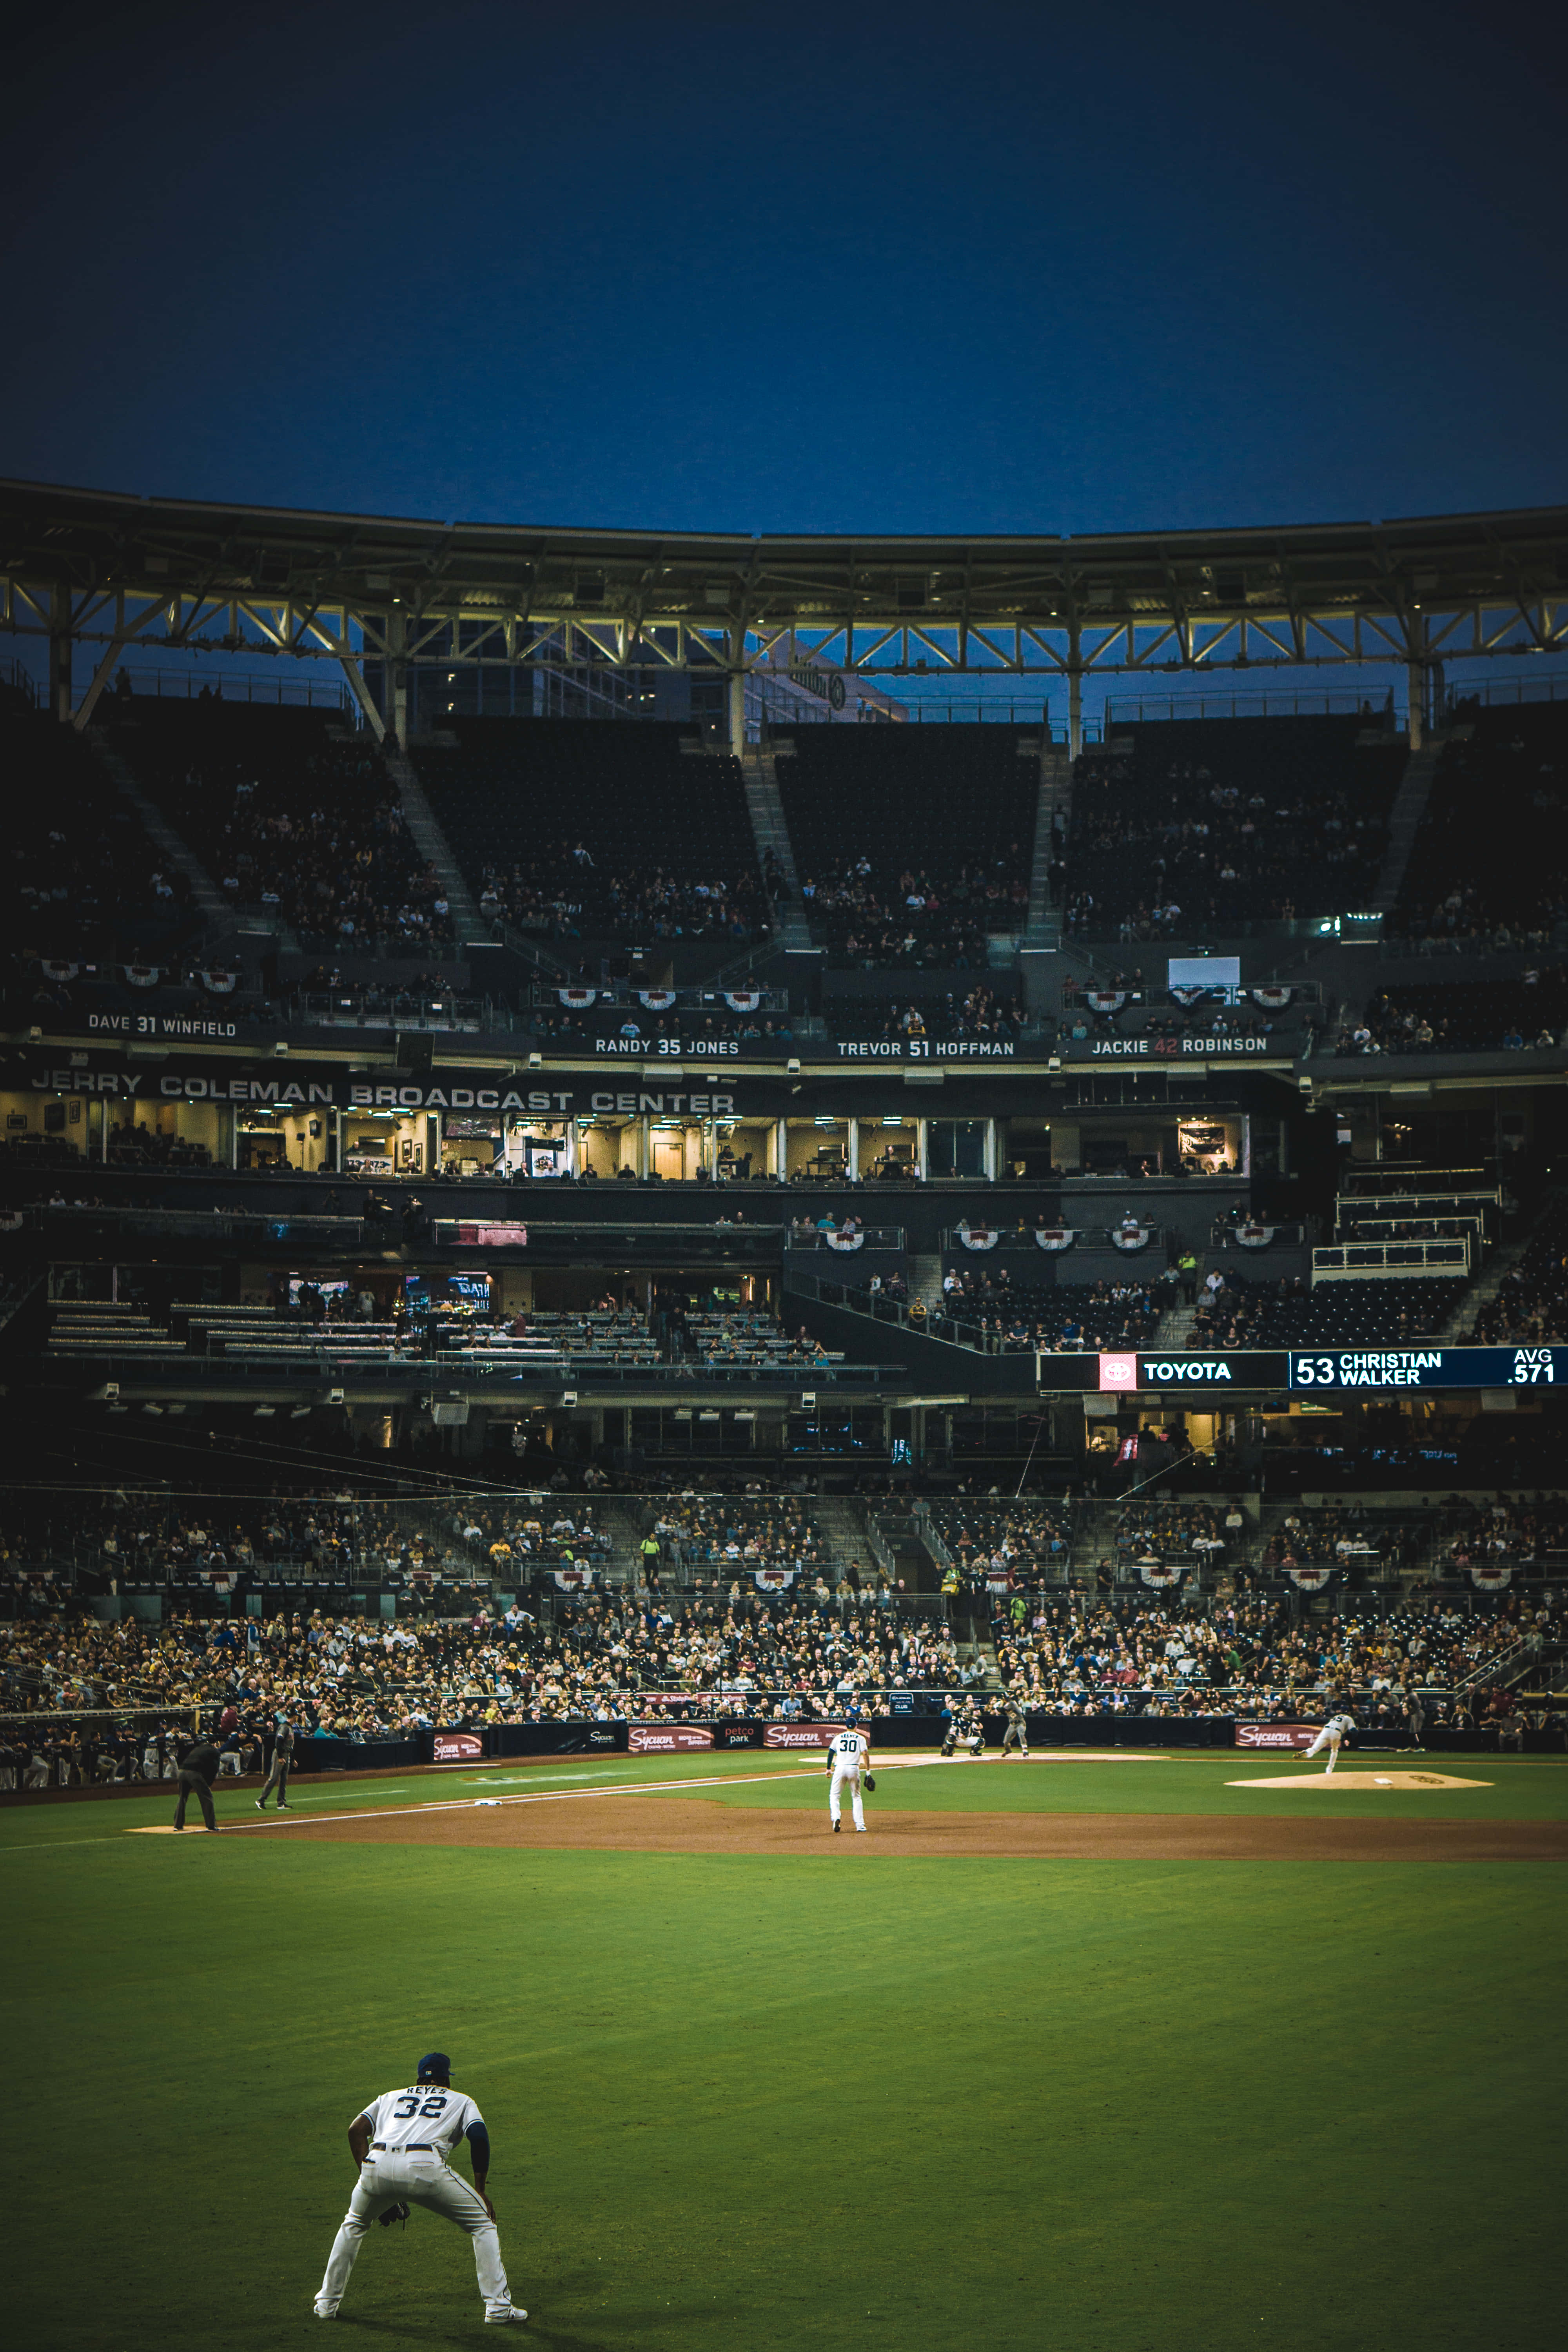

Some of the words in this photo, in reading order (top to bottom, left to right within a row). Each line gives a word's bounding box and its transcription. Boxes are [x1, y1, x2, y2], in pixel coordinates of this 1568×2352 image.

[89, 1014, 130, 1030] DAVE
[137, 1016, 156, 1033] 31
[163, 1019, 236, 1037] WINFIELD
[596, 1039, 651, 1053] RANDY
[658, 1039, 681, 1054] 35
[687, 1041, 739, 1054] JONES
[837, 1042, 901, 1056] TREVOR
[909, 1041, 929, 1056] 51
[936, 1042, 1014, 1055] HOFFMAN
[1092, 1040, 1149, 1054] JACKIE
[1154, 1038, 1177, 1053] 42
[1183, 1038, 1267, 1052] ROBINSON
[31, 1069, 143, 1093] JERRY
[160, 1076, 333, 1103] COLEMAN
[350, 1085, 573, 1110] BROADCAST
[591, 1092, 734, 1112] CENTER
[1340, 1352, 1441, 1369] CHRISTIAN
[1514, 1349, 1552, 1363] AVG
[1144, 1363, 1231, 1380] TOYOTA
[1297, 1358, 1334, 1384] 53
[1339, 1369, 1420, 1385] WALKER
[1508, 1364, 1553, 1383] .571
[590, 1731, 615, 1743] Sycuan
[630, 1729, 674, 1751] Sycuan
[725, 1727, 754, 1737] petco
[730, 1735, 750, 1744] park
[767, 1726, 820, 1747] Sycuan
[1239, 1726, 1292, 1746] Sycuan
[840, 1740, 857, 1752] 30
[394, 2096, 447, 2118] 32
